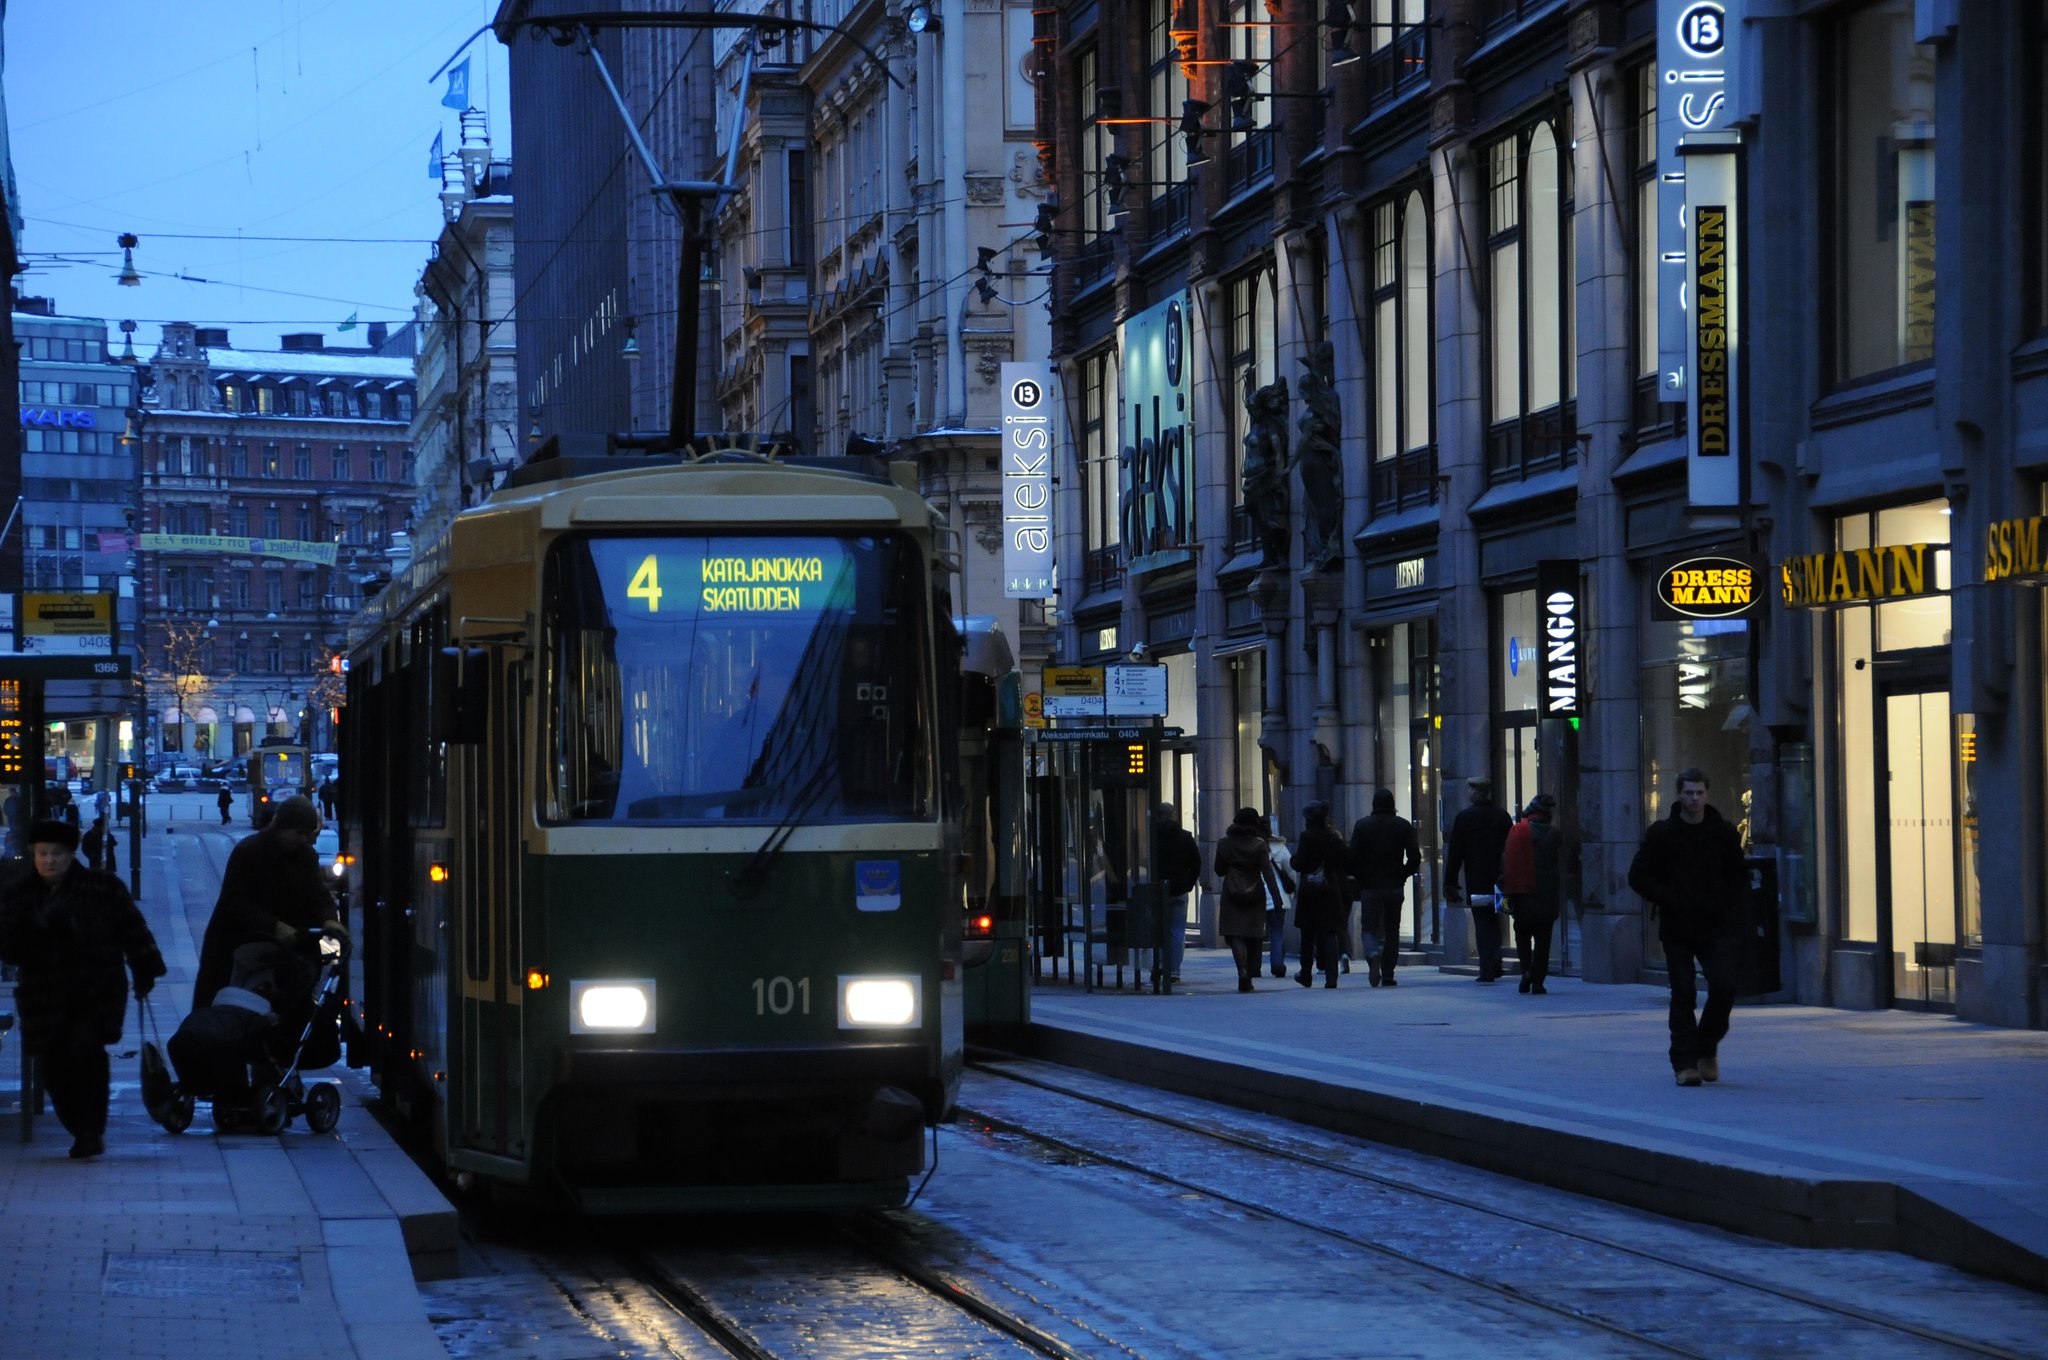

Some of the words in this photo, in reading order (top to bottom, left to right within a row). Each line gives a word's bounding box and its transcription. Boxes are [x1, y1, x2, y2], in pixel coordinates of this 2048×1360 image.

[1690, 14, 1719, 46] 13
[1700, 209, 1727, 453] DRESSMANN
[1168, 323, 1176, 366] 13
[1018, 386, 1034, 403] 13
[1005, 415, 1048, 552] aleksi
[1123, 393, 1184, 561] aleksi
[627, 554, 662, 612] 4
[702, 558, 822, 582] KATAJANOKKA
[1671, 569, 1752, 586] DRESS
[703, 588, 800, 611] SKATUDDEN
[1671, 587, 1752, 604] MANN
[79, 637, 113, 648] 0403
[1546, 592, 1577, 712] MANGO
[94, 663, 118, 673] 1366
[1115, 668, 1120, 676] 4
[1081, 697, 1102, 705] 0404
[1041, 731, 1109, 739] Aleksanterinkatu
[1118, 730, 1139, 738] 0404
[752, 976, 810, 1015] 101
